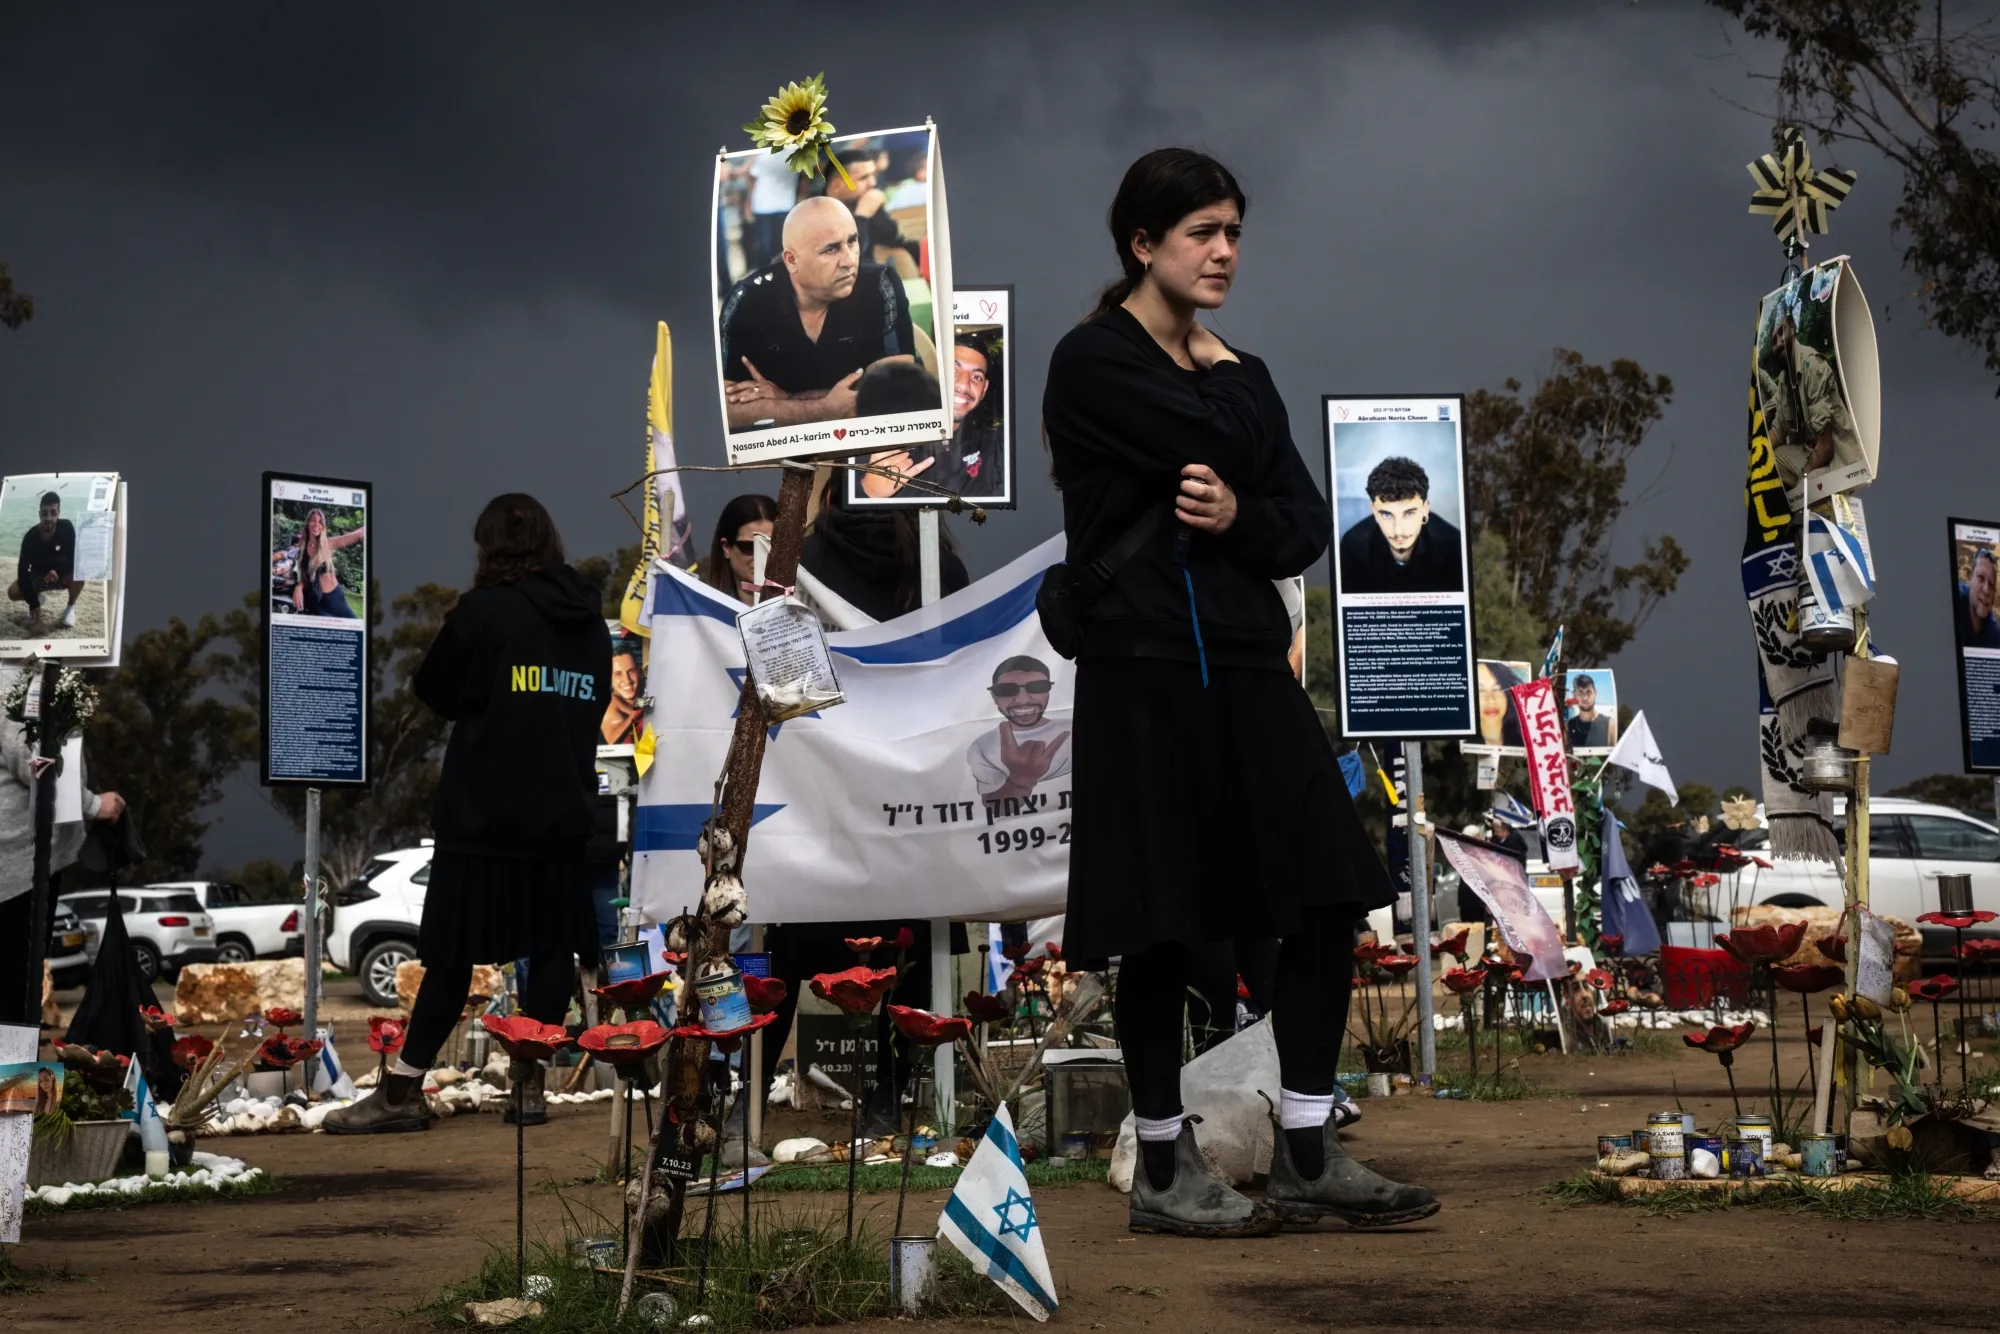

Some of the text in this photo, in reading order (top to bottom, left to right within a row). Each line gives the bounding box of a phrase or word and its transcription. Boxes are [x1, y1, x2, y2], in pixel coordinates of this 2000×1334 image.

[849, 420, 942, 438] נסאסרה עבד אל-כרים
[732, 432, 831, 452] Nasasra Abed Al-karim
[932, 801, 974, 824] דוד
[986, 794, 1047, 826] יצחק
[977, 822, 1072, 854] 1999-2
[662, 1157, 691, 1170] 7.10.23
